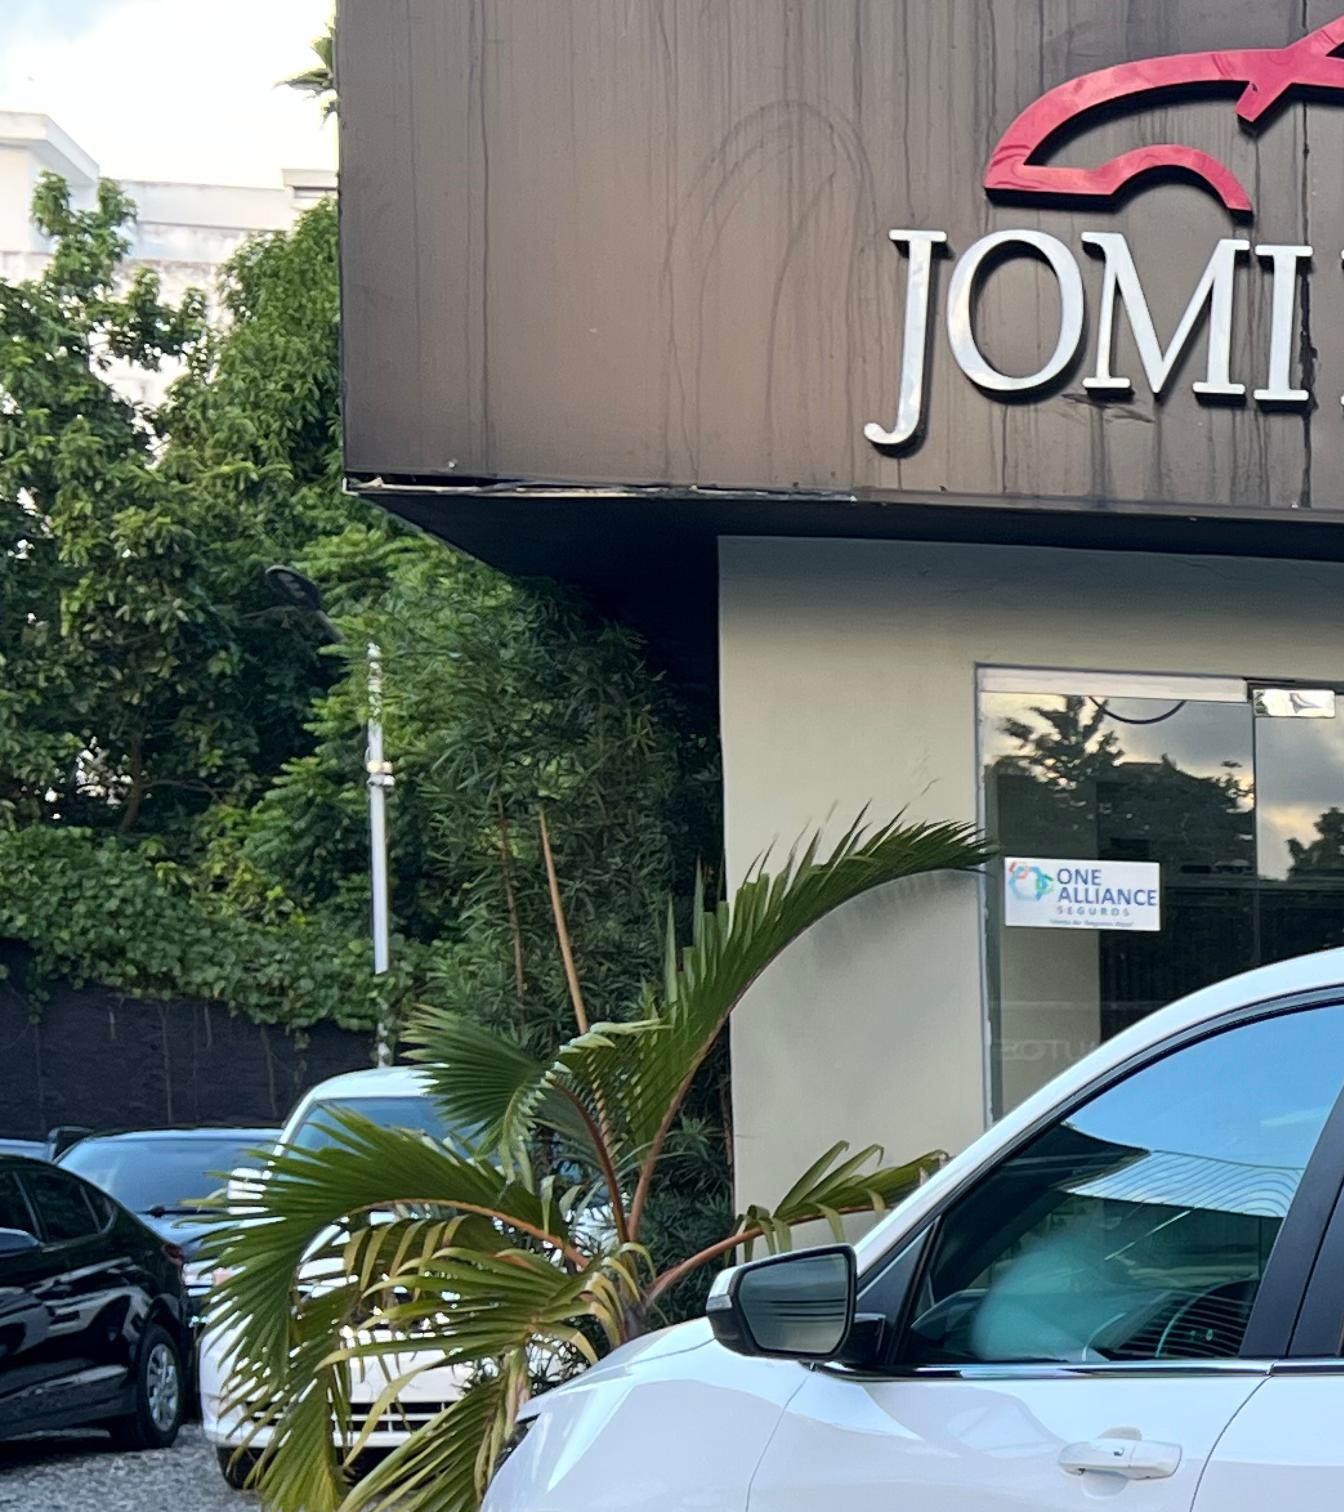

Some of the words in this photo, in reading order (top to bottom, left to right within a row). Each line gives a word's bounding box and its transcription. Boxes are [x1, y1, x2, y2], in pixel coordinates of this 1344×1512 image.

[863, 228, 1313, 448] JOMI
[1057, 868, 1102, 886] ONE
[1057, 887, 1158, 907] ALLIANCE
[1056, 906, 1131, 917] SEGUROS
